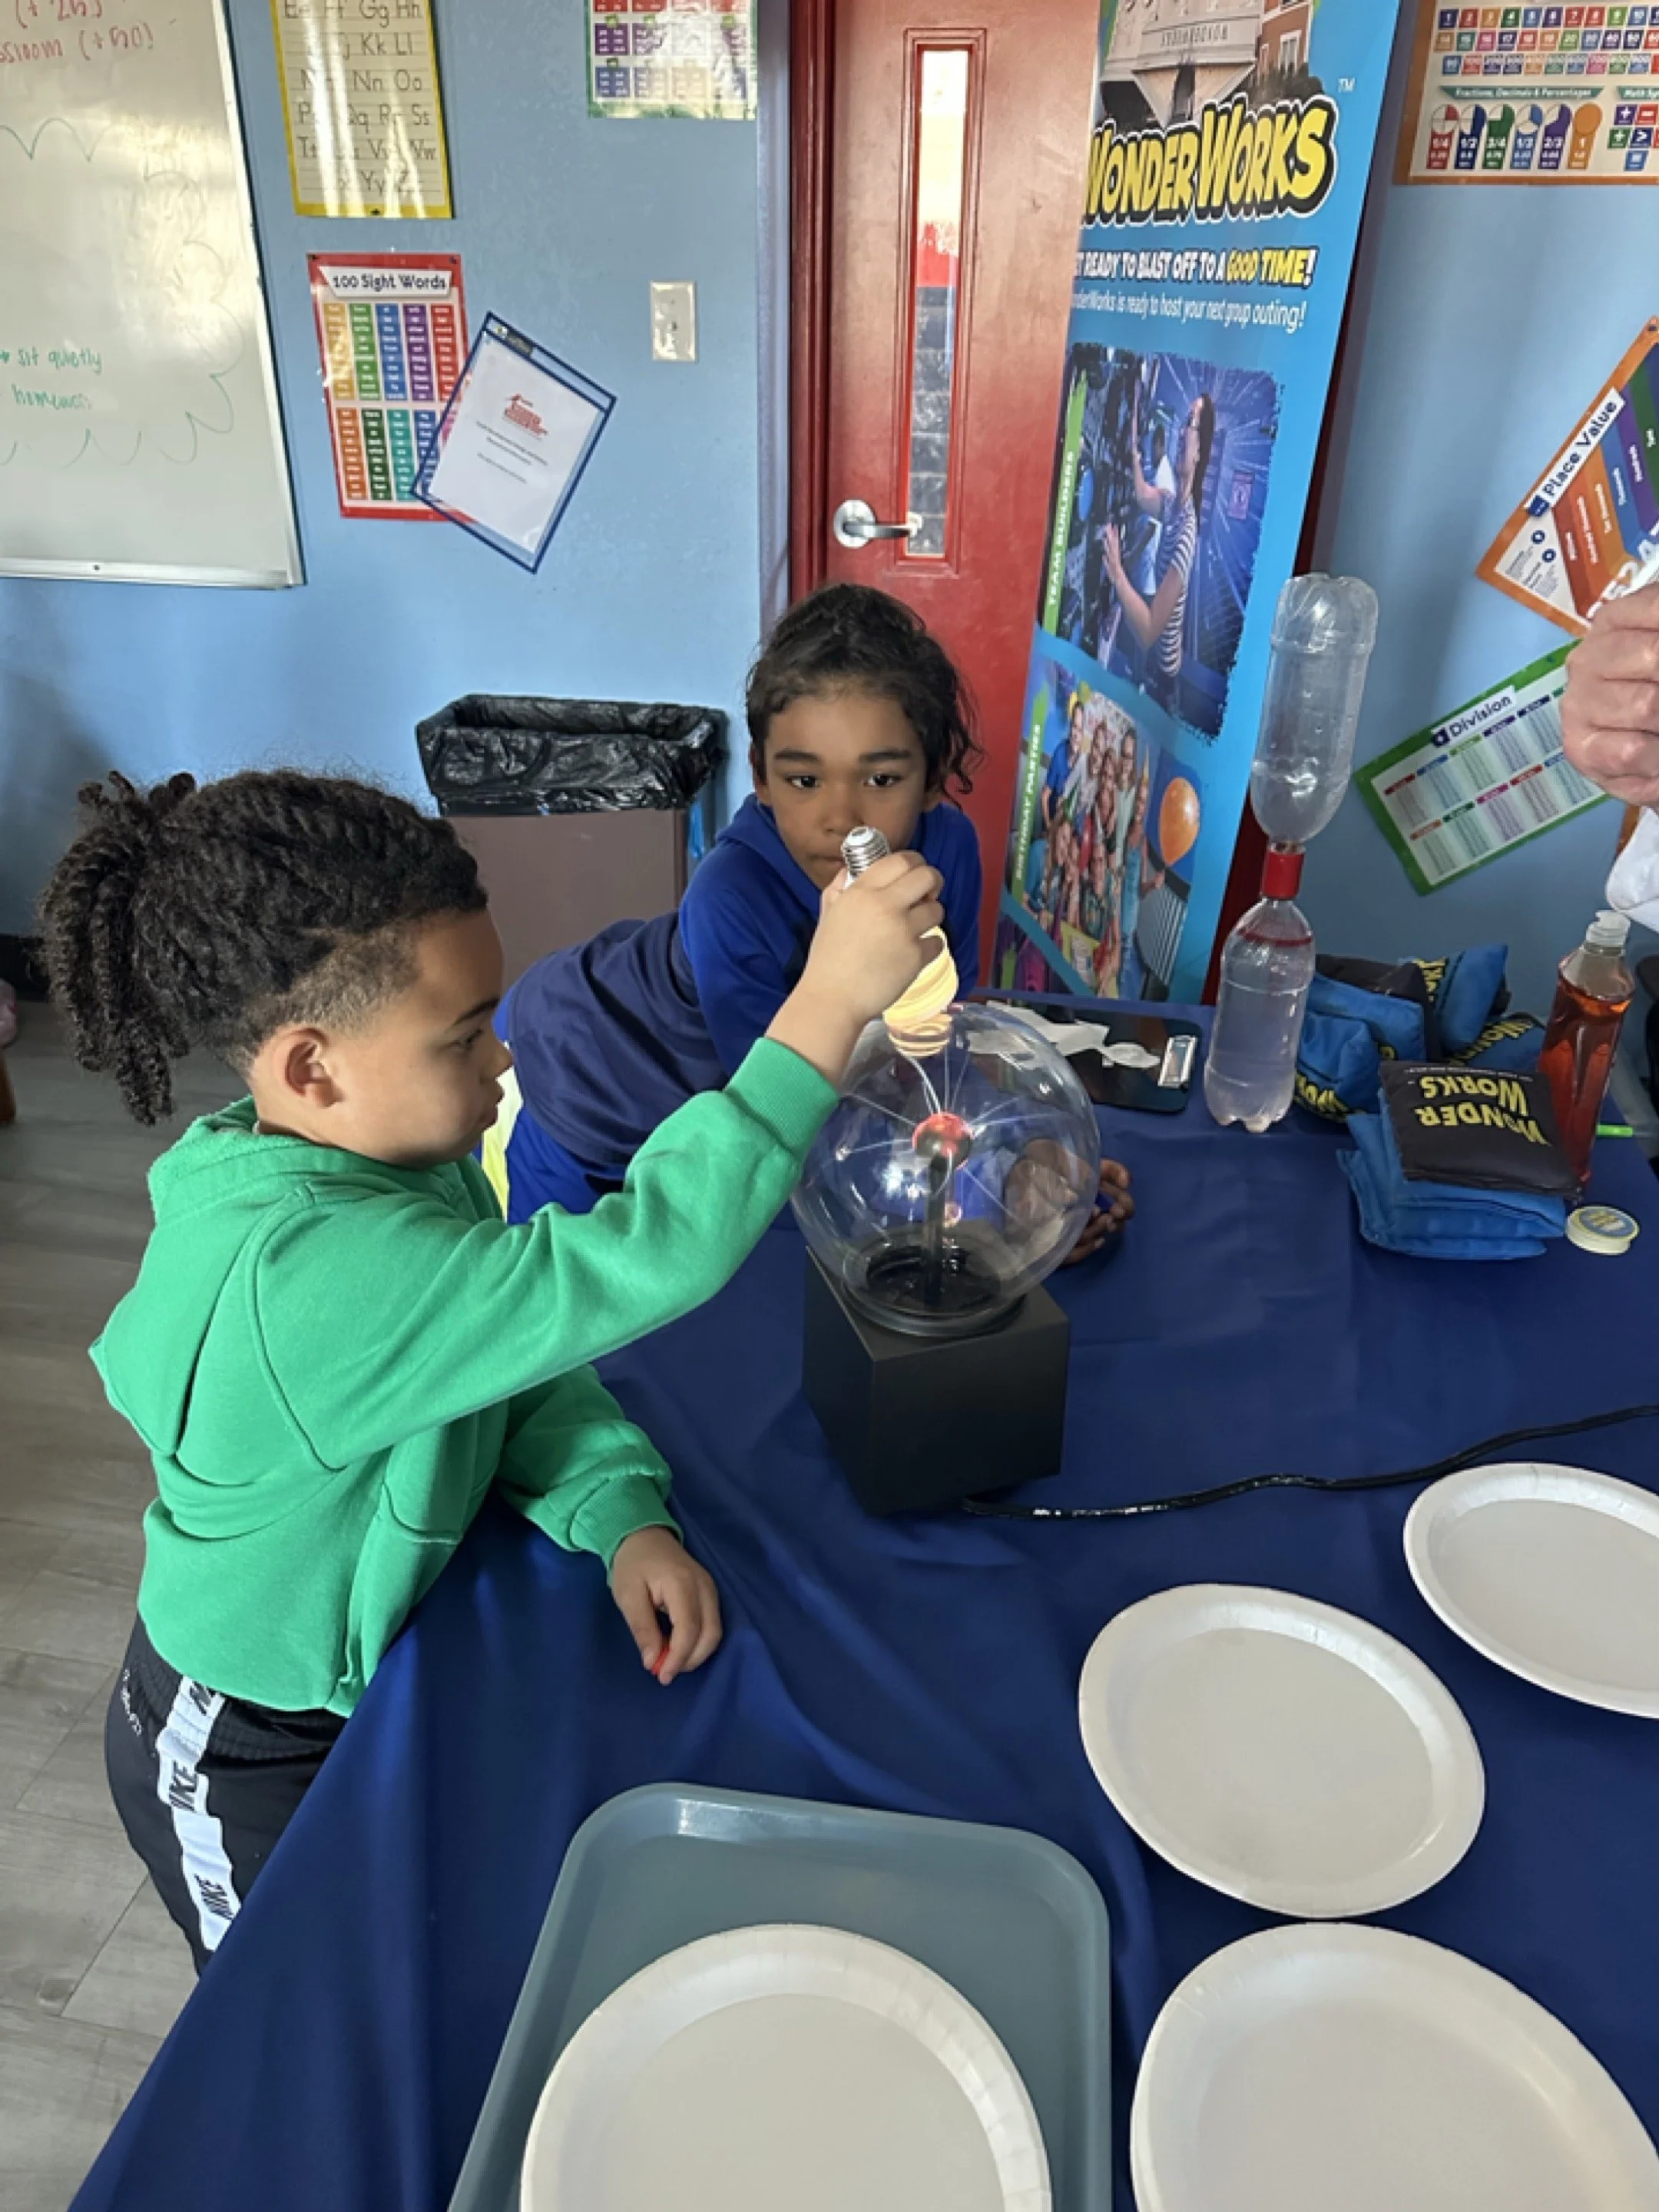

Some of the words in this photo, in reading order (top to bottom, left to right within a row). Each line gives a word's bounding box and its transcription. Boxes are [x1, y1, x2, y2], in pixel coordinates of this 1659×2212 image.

[361, 32, 387, 56] Kk
[353, 69, 383, 91] Nn
[333, 275, 359, 288] 100
[361, 273, 397, 293] Sight
[398, 274, 445, 290] Words
[1083, 251, 1121, 279] READY
[1122, 251, 1137, 279] TO
[1137, 250, 1173, 280] BLAST
[1173, 250, 1198, 281] OFF
[1199, 250, 1217, 281] TO
[1215, 250, 1227, 281] A
[1227, 249, 1260, 282] GOOD
[1260, 248, 1318, 286] TIME!
[1252, 297, 1307, 334] outing!
[1542, 451, 1581, 496] Place
[1575, 402, 1617, 447] Value
[1449, 696, 1511, 737] Division
[1419, 1075, 1529, 1117] WORKS
[1414, 1101, 1552, 1147] WONDER
[169, 1760, 197, 1813] NIKE
